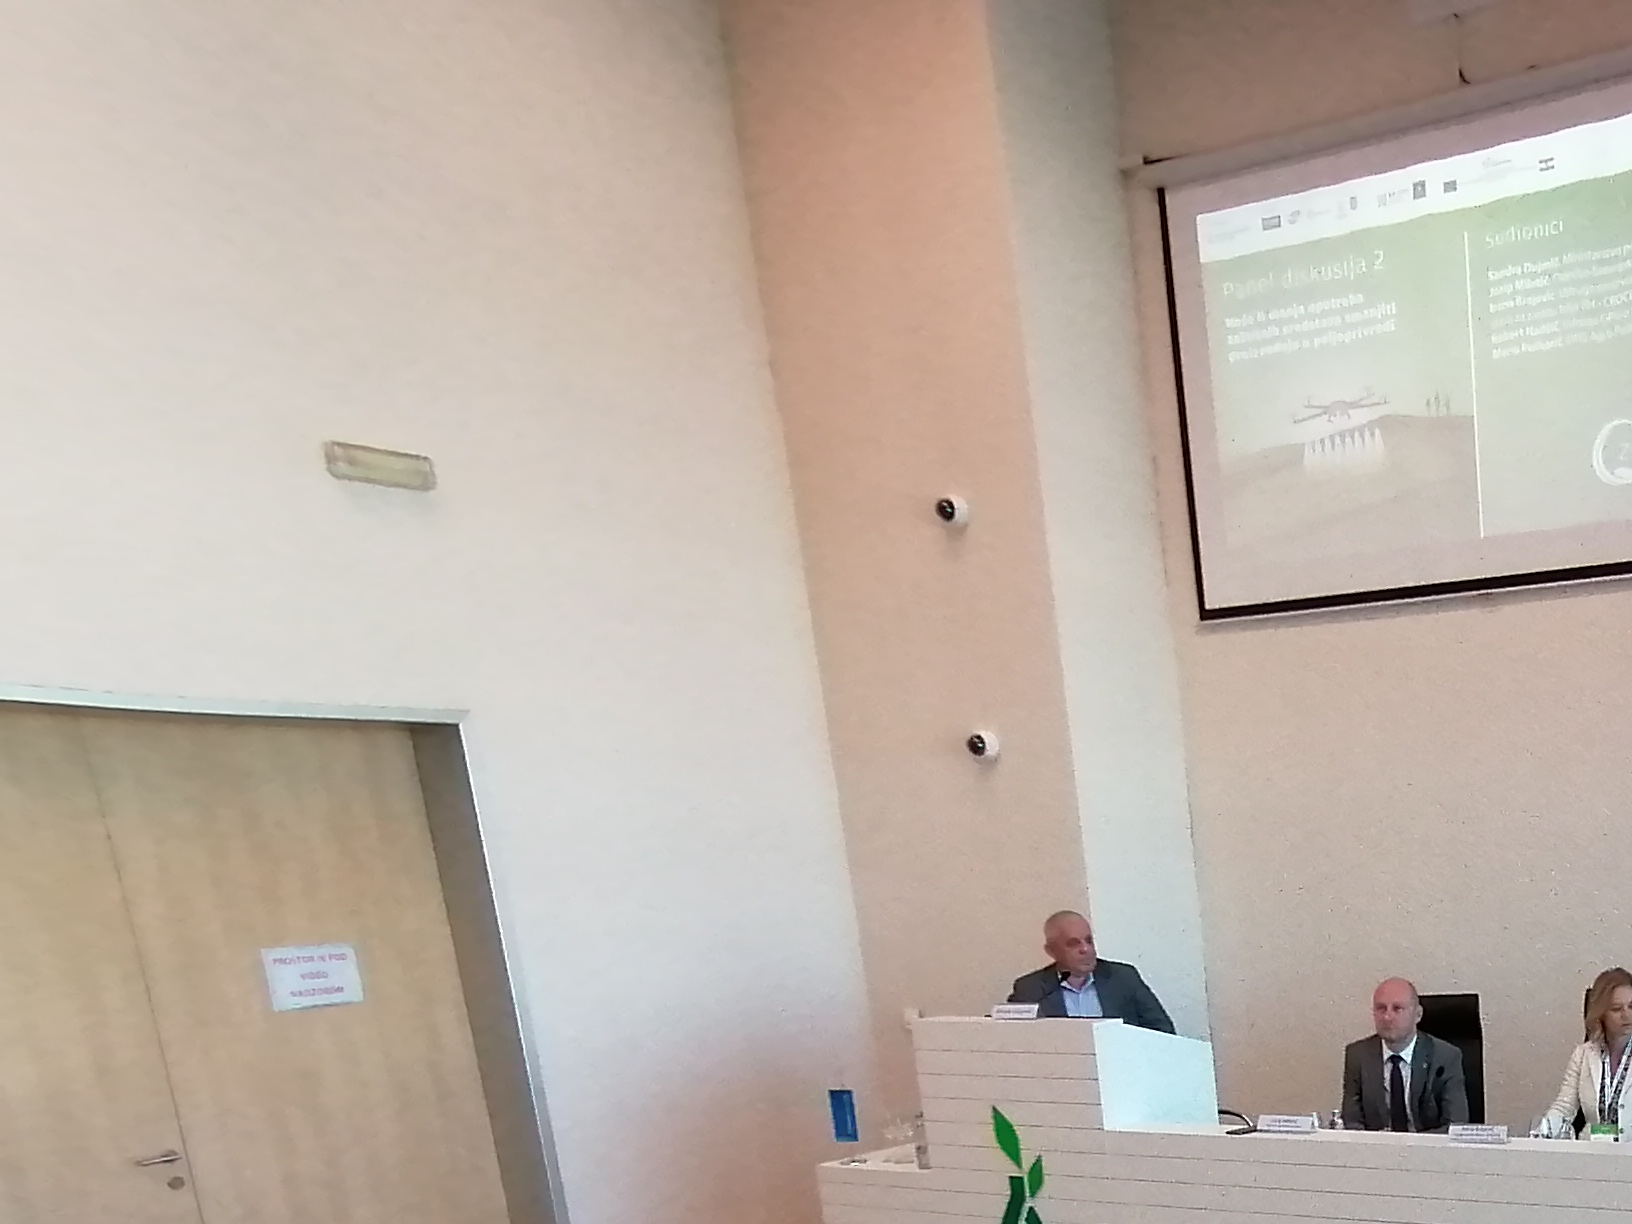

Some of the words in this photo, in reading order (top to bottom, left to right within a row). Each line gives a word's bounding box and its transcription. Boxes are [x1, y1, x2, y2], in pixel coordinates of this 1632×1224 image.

[1222, 272, 1274, 300] Panel
[1282, 254, 1367, 289] diskusija
[1372, 250, 1385, 270] 2
[328, 952, 348, 962] POD
